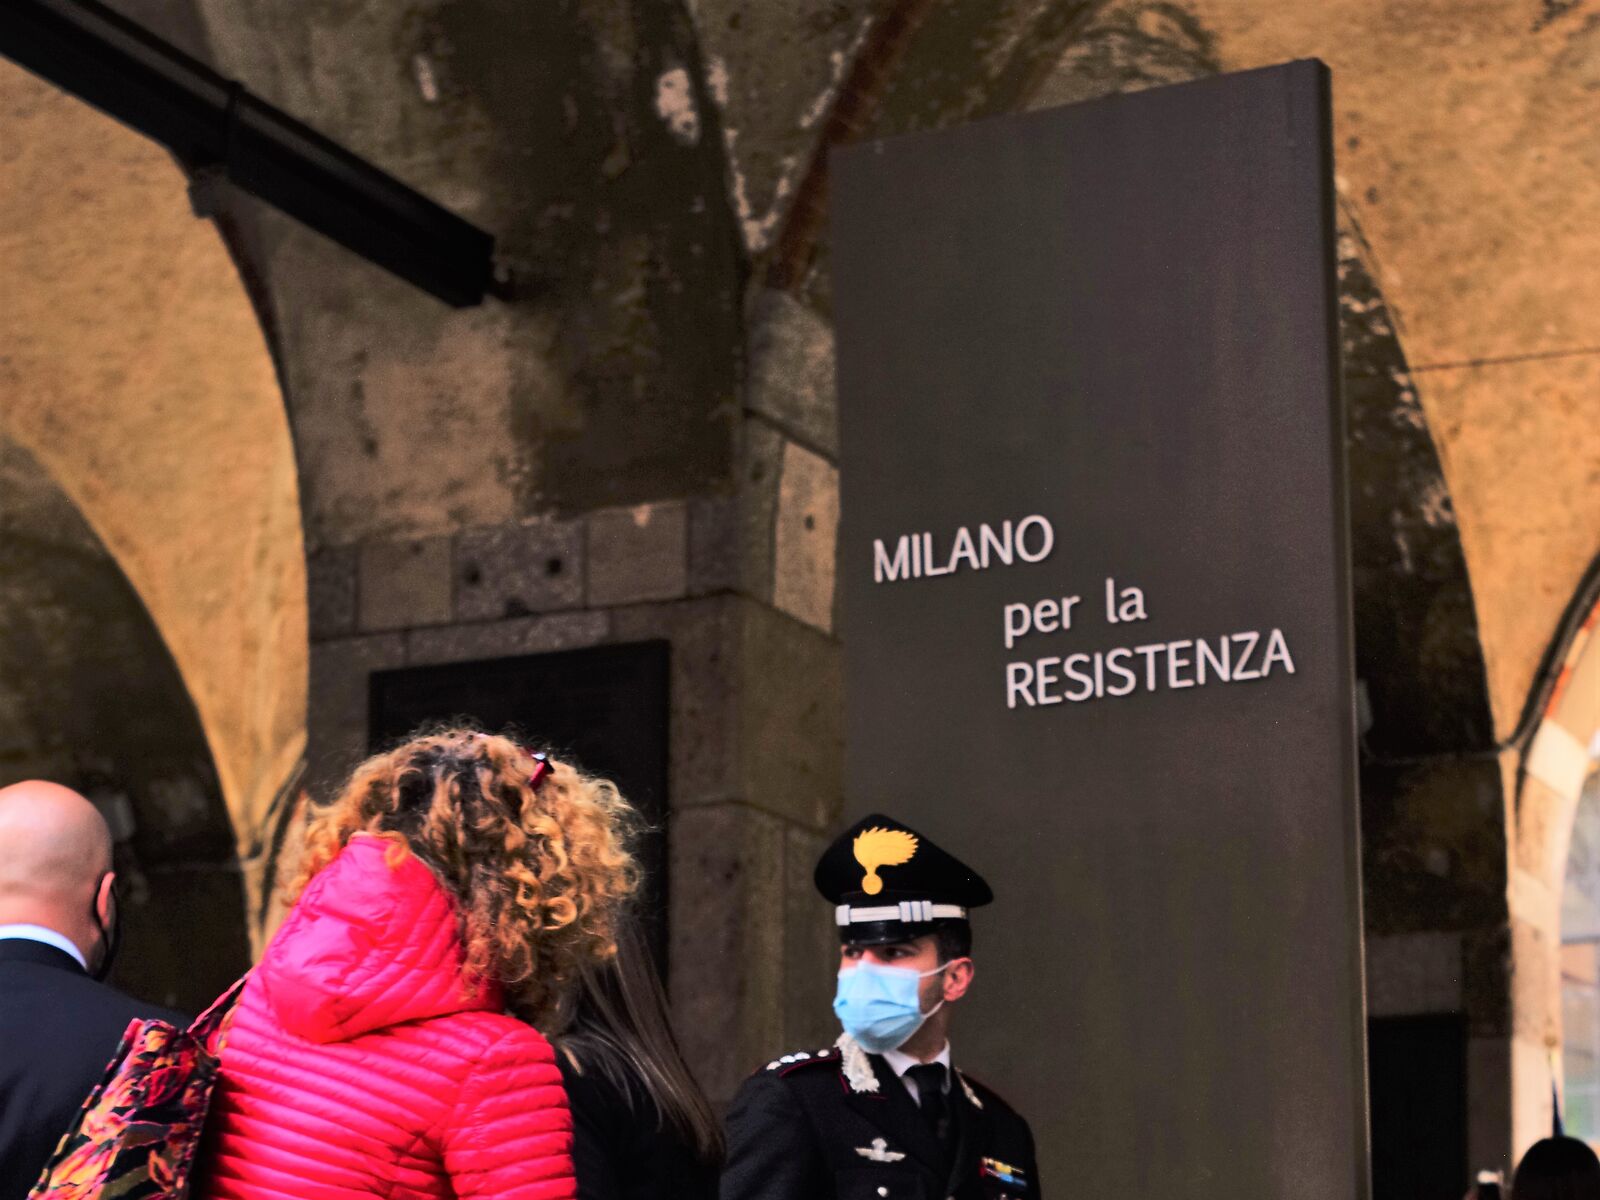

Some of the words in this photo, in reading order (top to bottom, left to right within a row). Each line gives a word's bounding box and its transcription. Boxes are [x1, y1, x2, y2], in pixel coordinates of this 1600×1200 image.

[873, 514, 1055, 583] MILANO
[1004, 595, 1081, 649] per
[1105, 577, 1148, 624] la
[1006, 628, 1296, 709] RESISTENZA
